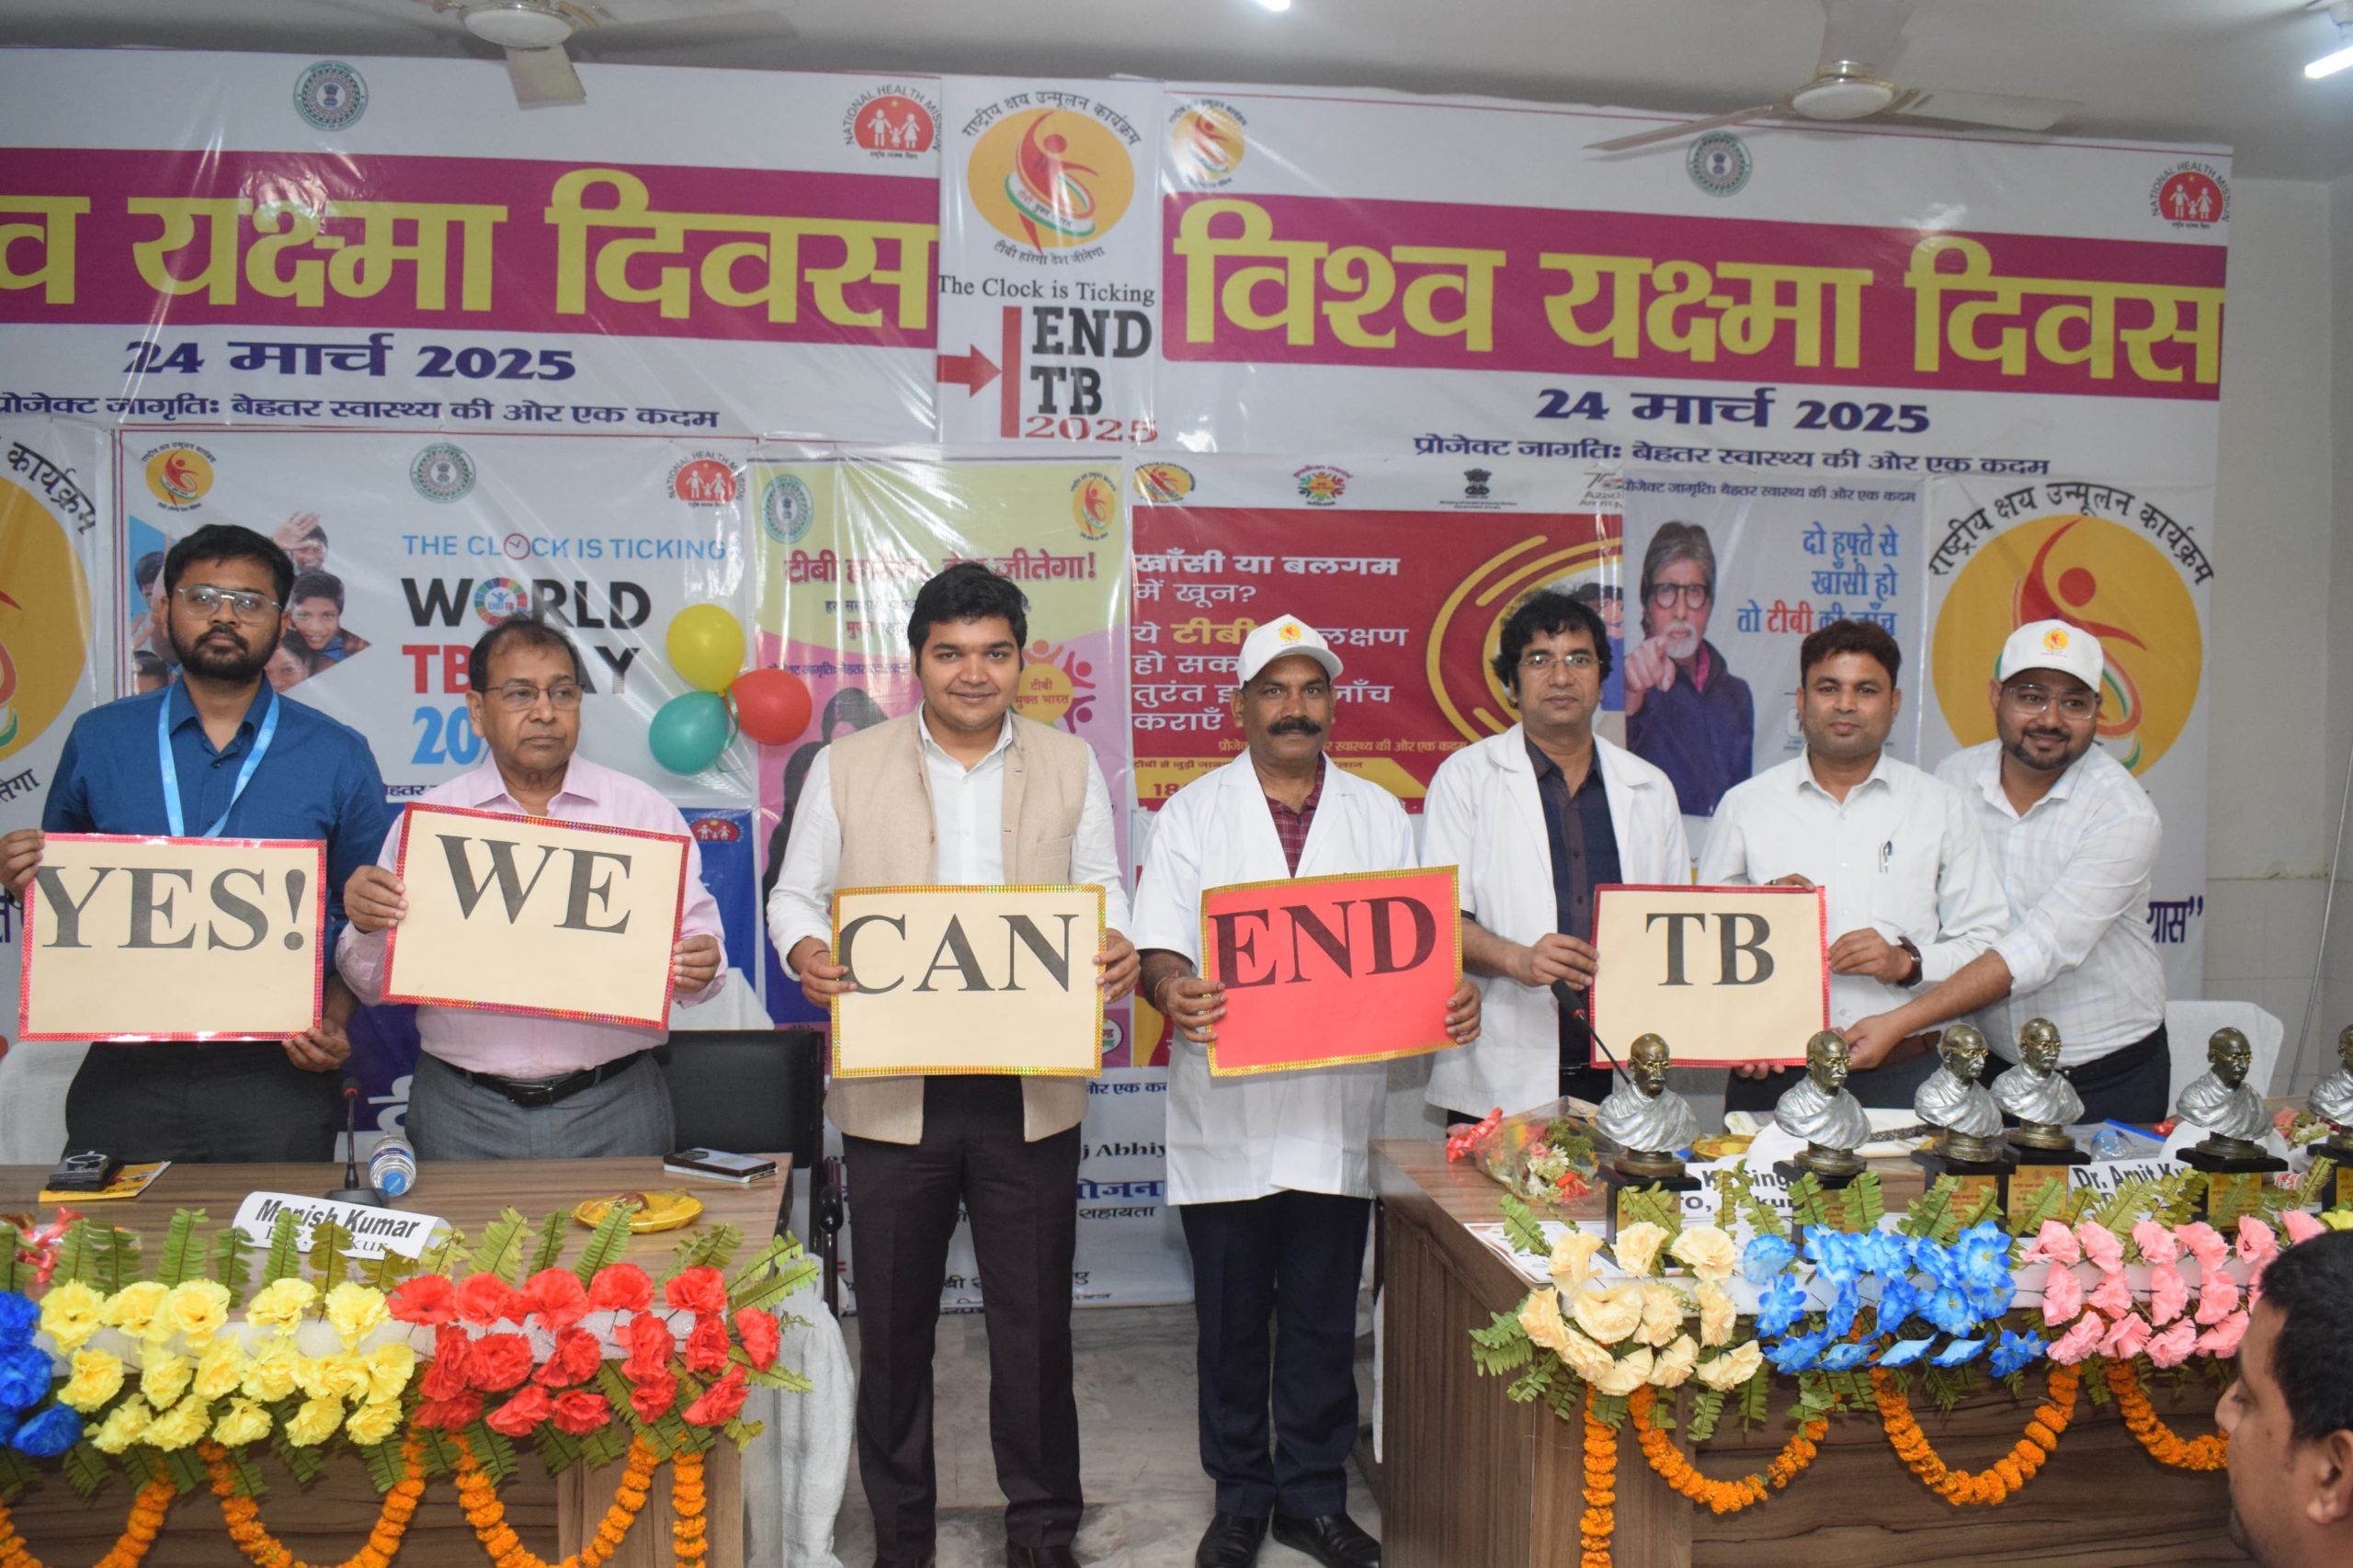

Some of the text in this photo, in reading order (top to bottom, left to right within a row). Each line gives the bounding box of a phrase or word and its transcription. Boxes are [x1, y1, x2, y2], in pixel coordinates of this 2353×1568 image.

[877, 85, 925, 102] HEALTH
[128, 197, 508, 312] यक्ष्मा
[544, 168, 939, 330] दिवस
[938, 275, 1155, 306] The Clock is Ticking
[1173, 199, 2225, 383] विश्व यक्ष्मा दिवस
[1031, 306, 1153, 358] END
[122, 333, 576, 381] 24 मार्च 2025
[1030, 366, 1103, 415] TB
[232, 393, 323, 417] बेहतर
[450, 397, 494, 420] की
[503, 399, 564, 422] ओर
[571, 405, 628, 424] एक
[635, 407, 720, 427] कदम
[1534, 387, 1930, 434] 24 मार्च 2025
[1025, 415, 1158, 443] 2025
[1414, 433, 1512, 456] प्रोजेक्ट
[1631, 440, 1712, 463] बेहतर
[1822, 448, 1860, 469] की
[1869, 450, 1919, 472] ओर
[1926, 456, 1973, 473] एक
[1980, 458, 2051, 475] कदम
[7, 441, 96, 535] कार्यक्रम
[403, 532, 726, 560] THE CLOCK IS TICKING
[1802, 521, 1827, 554] दो
[1879, 524, 1899, 557] से
[1928, 482, 2214, 585] राष्ट्रीय क्षय उन्मूलन कार्यक्रम
[1233, 556, 1275, 574] या
[1282, 556, 1401, 575] बलगम
[1874, 563, 1899, 601] हो
[401, 577, 652, 630] WORLD
[1131, 579, 1256, 608] में खून?
[1132, 621, 1161, 643] ये
[1737, 599, 1762, 633] तो
[1767, 599, 1814, 633] टीबी
[1132, 650, 1165, 675] हो
[1030, 678, 1053, 691] टीबी
[1042, 693, 1069, 705] भारत
[1376, 739, 1392, 751] की
[1394, 739, 1415, 751] ओर
[1417, 741, 1436, 752] एक
[436, 834, 632, 935] WE
[34, 865, 307, 951] YES!
[838, 913, 1080, 994] CAN
[1208, 895, 1437, 990] END
[1645, 912, 1775, 986] TB
[1114, 1082, 1141, 1095] एक
[2072, 1166, 2108, 1189] Dr.
[343, 1209, 420, 1239] Kumar
